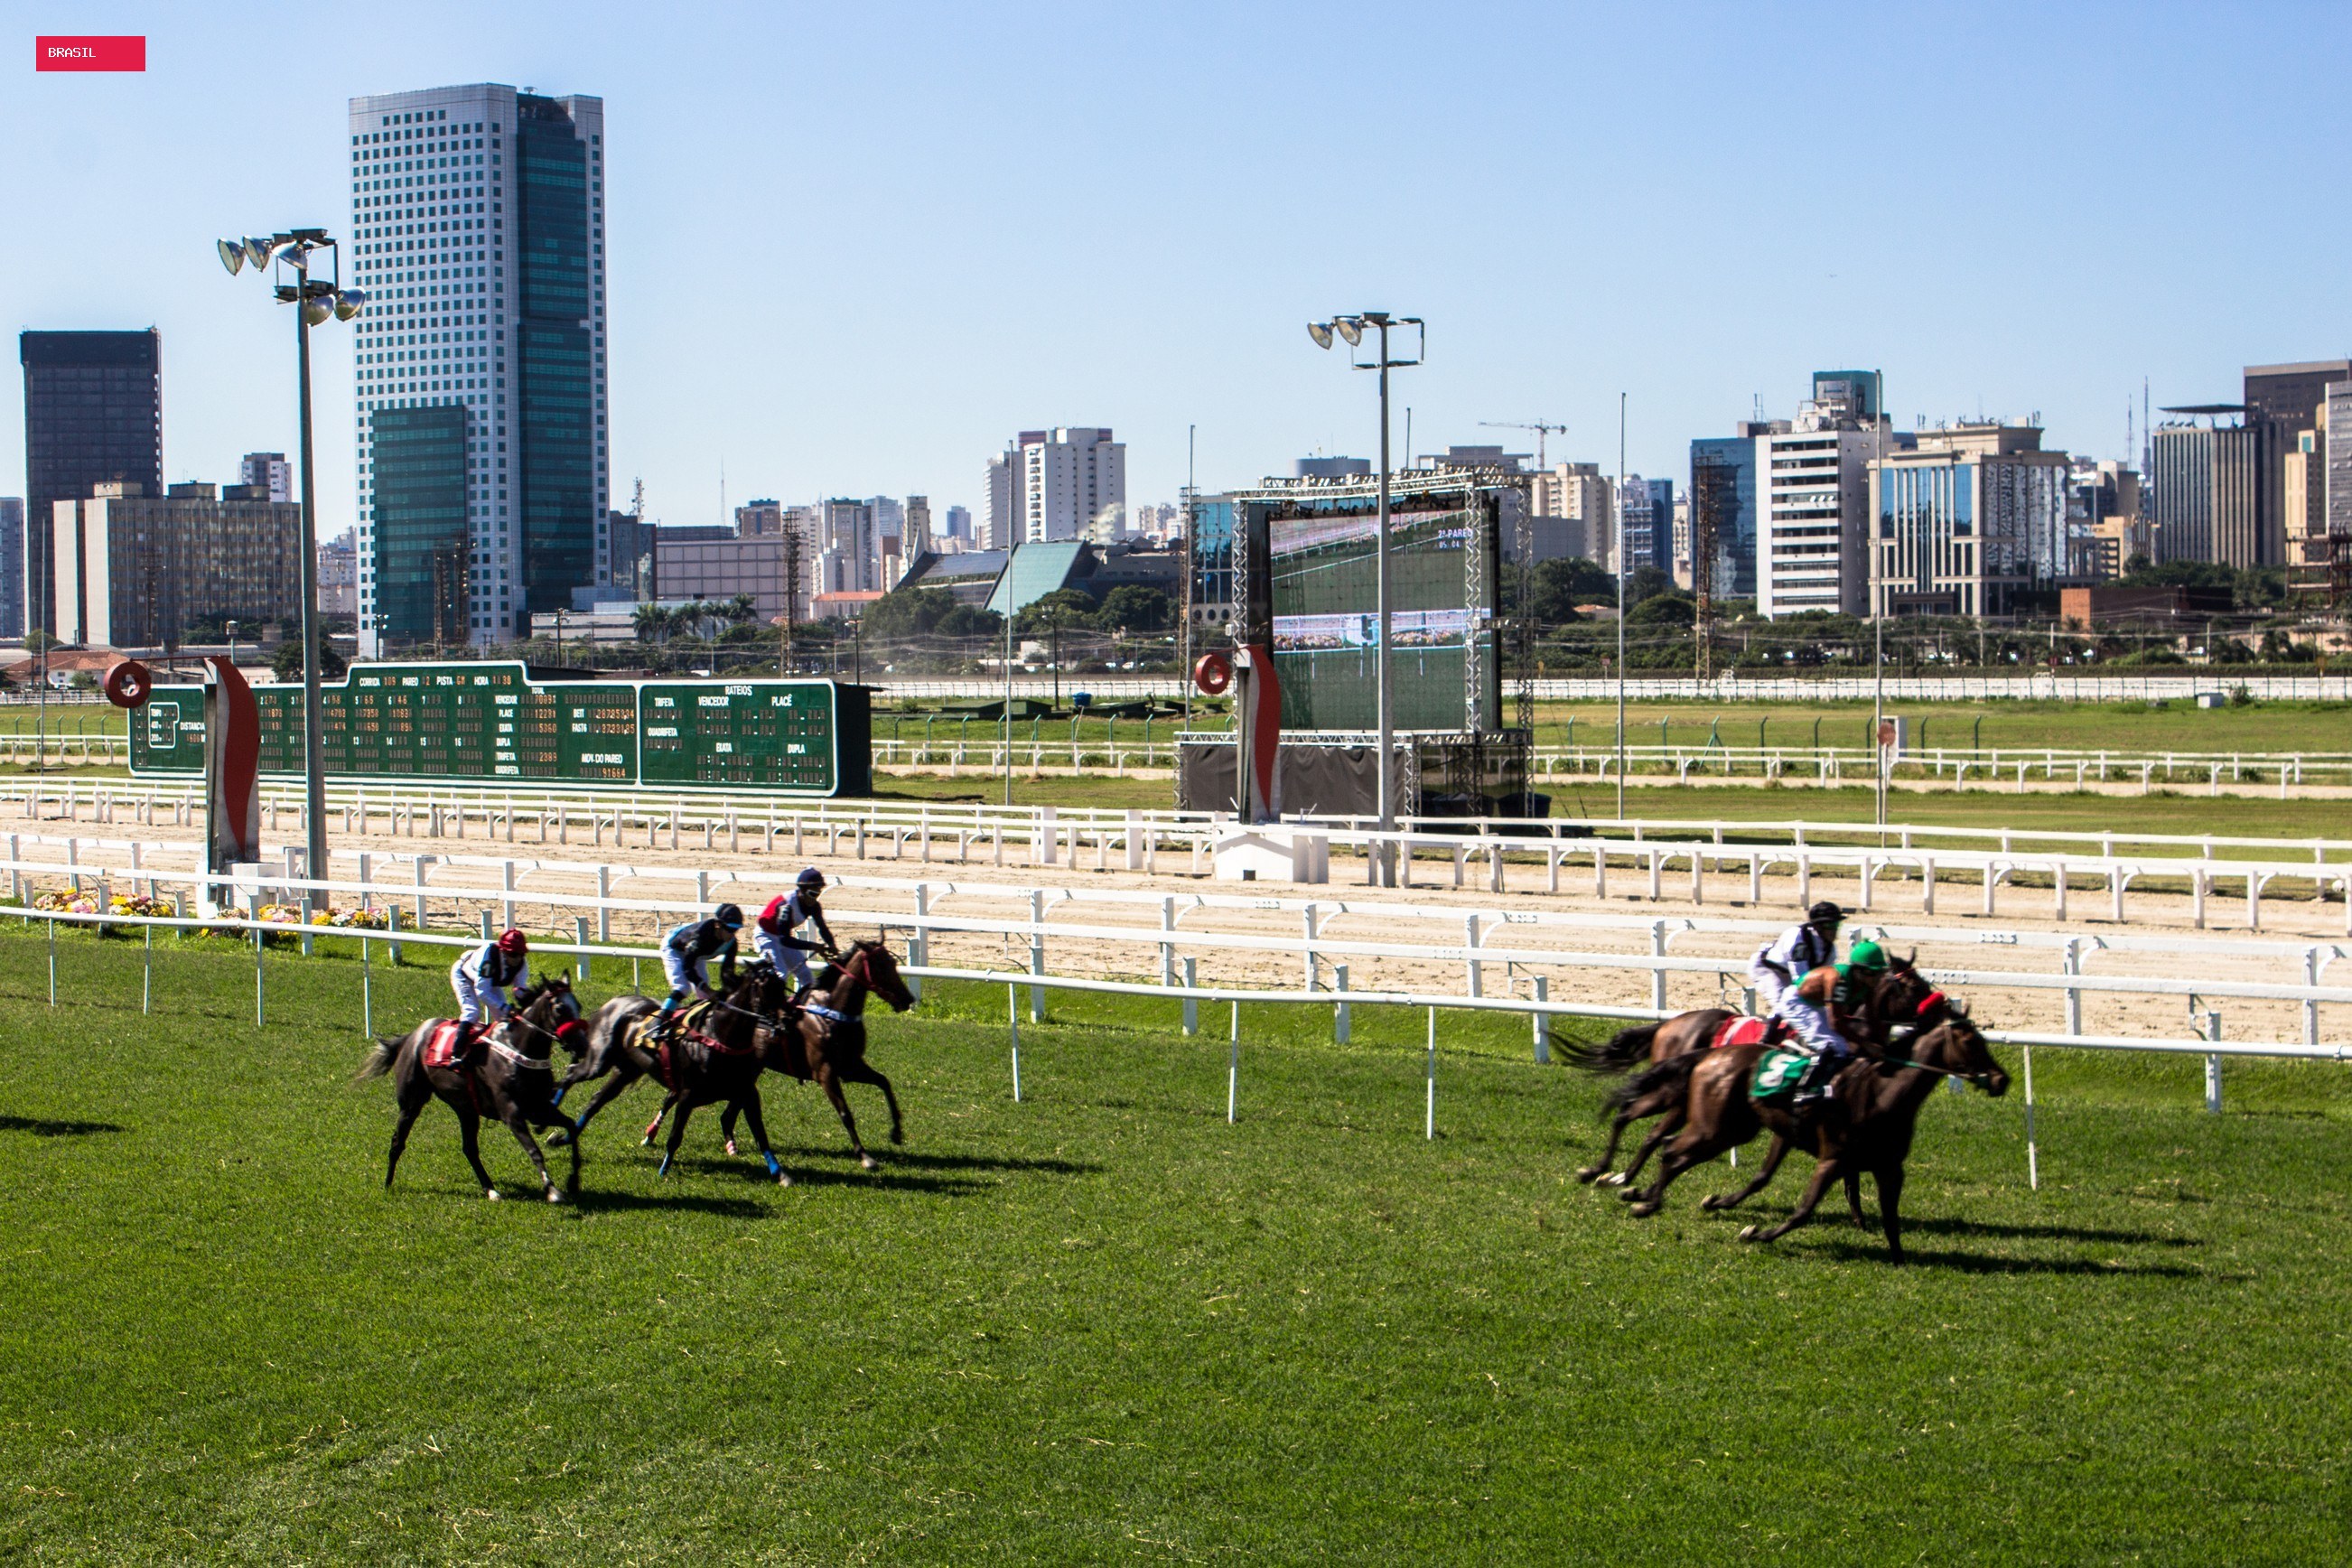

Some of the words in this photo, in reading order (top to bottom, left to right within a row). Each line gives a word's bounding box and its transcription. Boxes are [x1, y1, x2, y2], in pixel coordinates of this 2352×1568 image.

[359, 677, 381, 686] CORRIDA
[401, 677, 419, 686] PAREO
[436, 676, 453, 686] PISTA
[473, 676, 490, 686] HORA
[725, 686, 752, 695] RATEIOS
[495, 695, 518, 705] VENCEDOR
[698, 695, 730, 706] VENCEDOR
[181, 722, 206, 731] DISTANCIA
[497, 737, 511, 746] DUPLA
[715, 742, 733, 752] EXATA
[788, 744, 806, 753] DUPLA
[594, 753, 603, 764] DO
[605, 753, 623, 764] PAREO
[435, 1026, 458, 1061] 1
